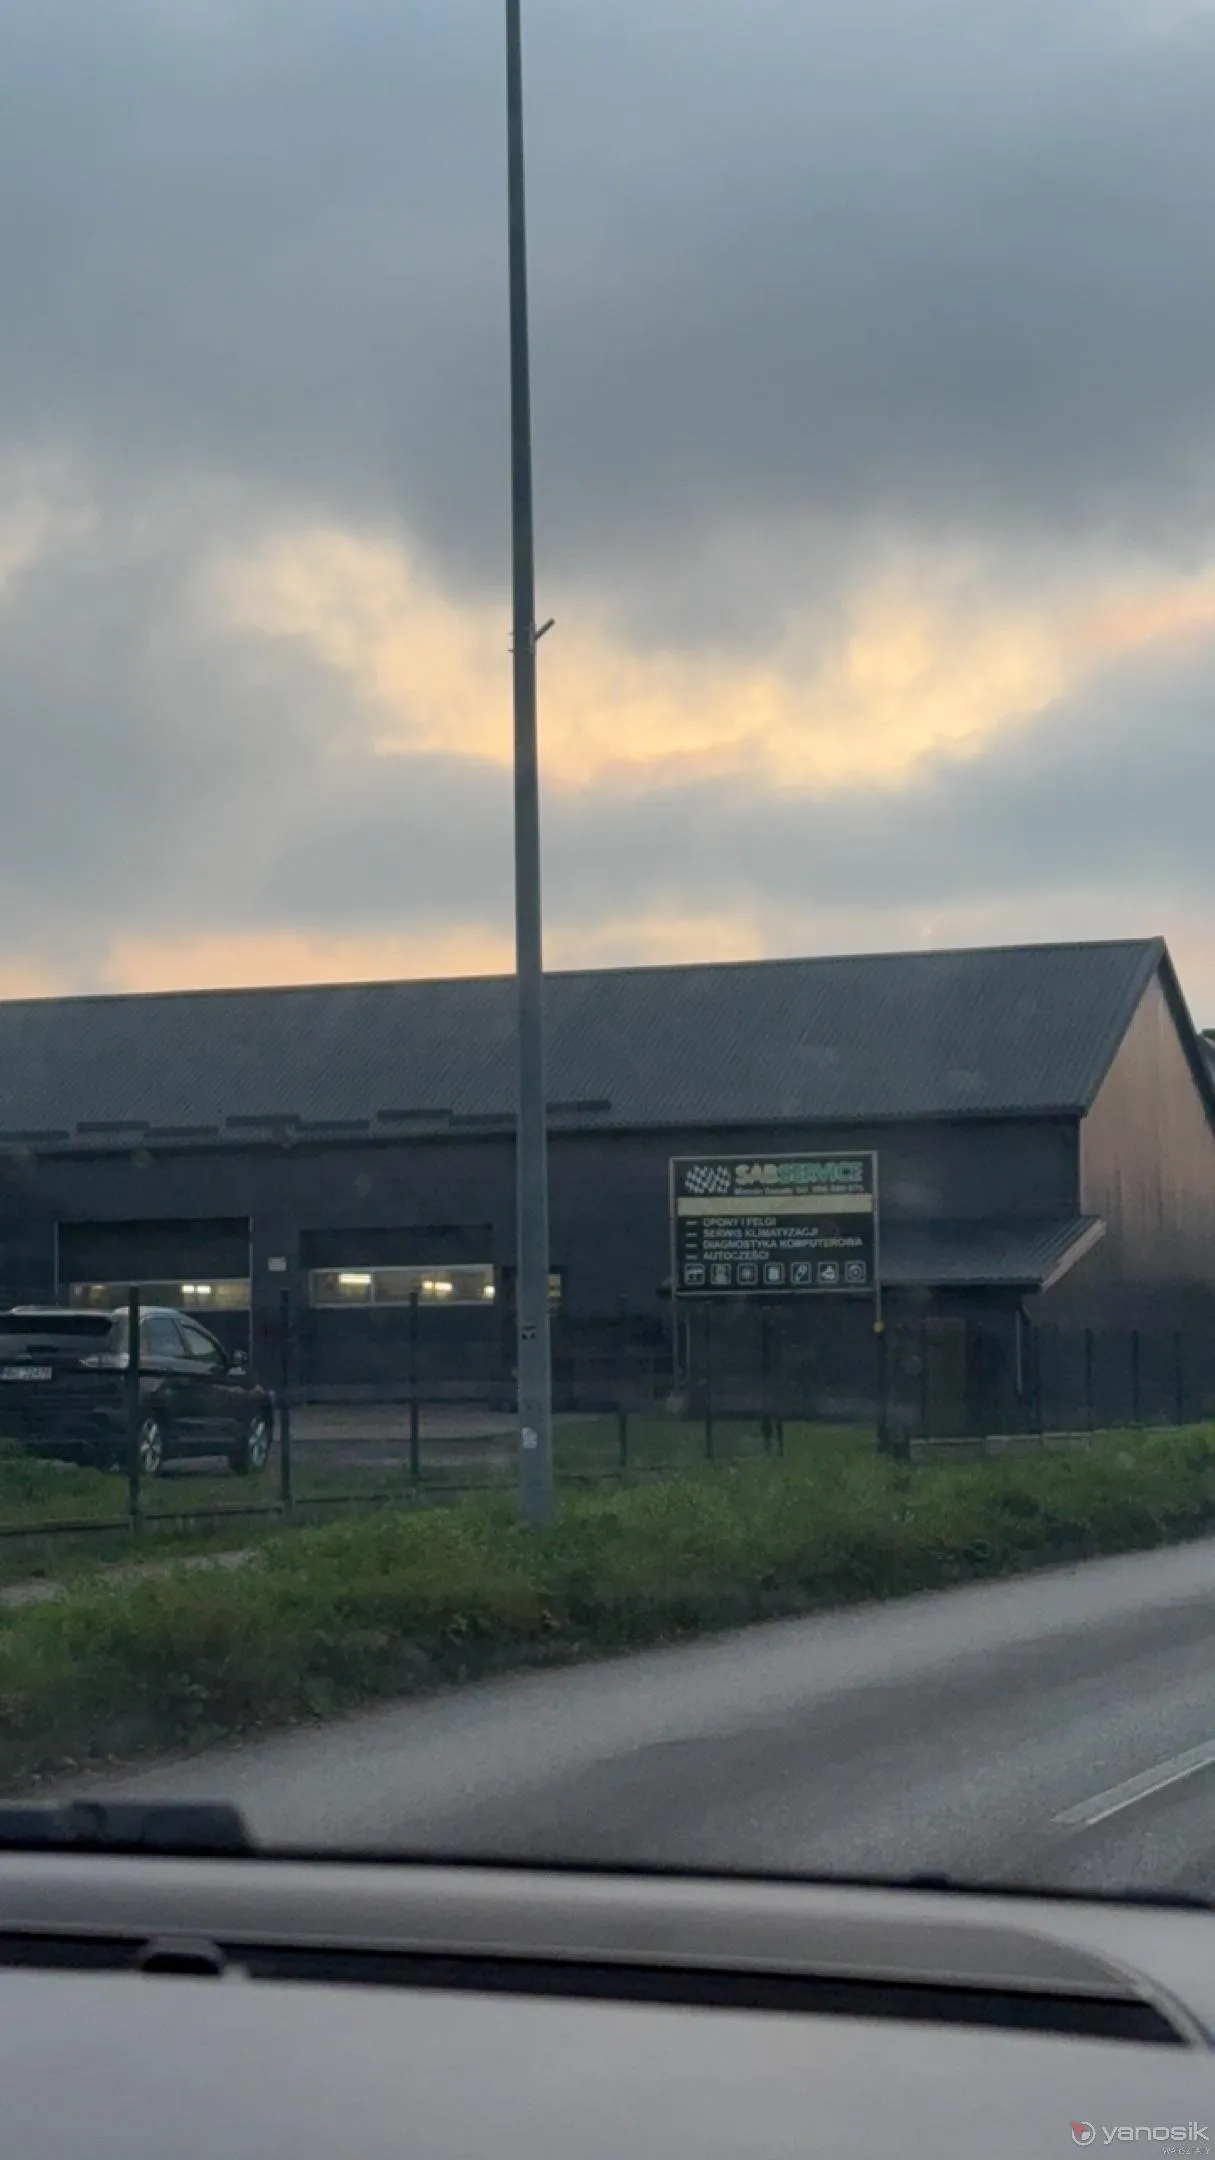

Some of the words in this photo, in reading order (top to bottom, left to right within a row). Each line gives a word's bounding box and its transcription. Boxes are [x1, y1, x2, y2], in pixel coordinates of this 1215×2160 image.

[703, 1217, 738, 1227] OPONY
[746, 1217, 777, 1226] FELGI
[703, 1228, 742, 1238] SERWIS
[703, 1239, 777, 1249] DIAGNOSTYKA
[779, 1236, 863, 1248] KOMPUTEROWA
